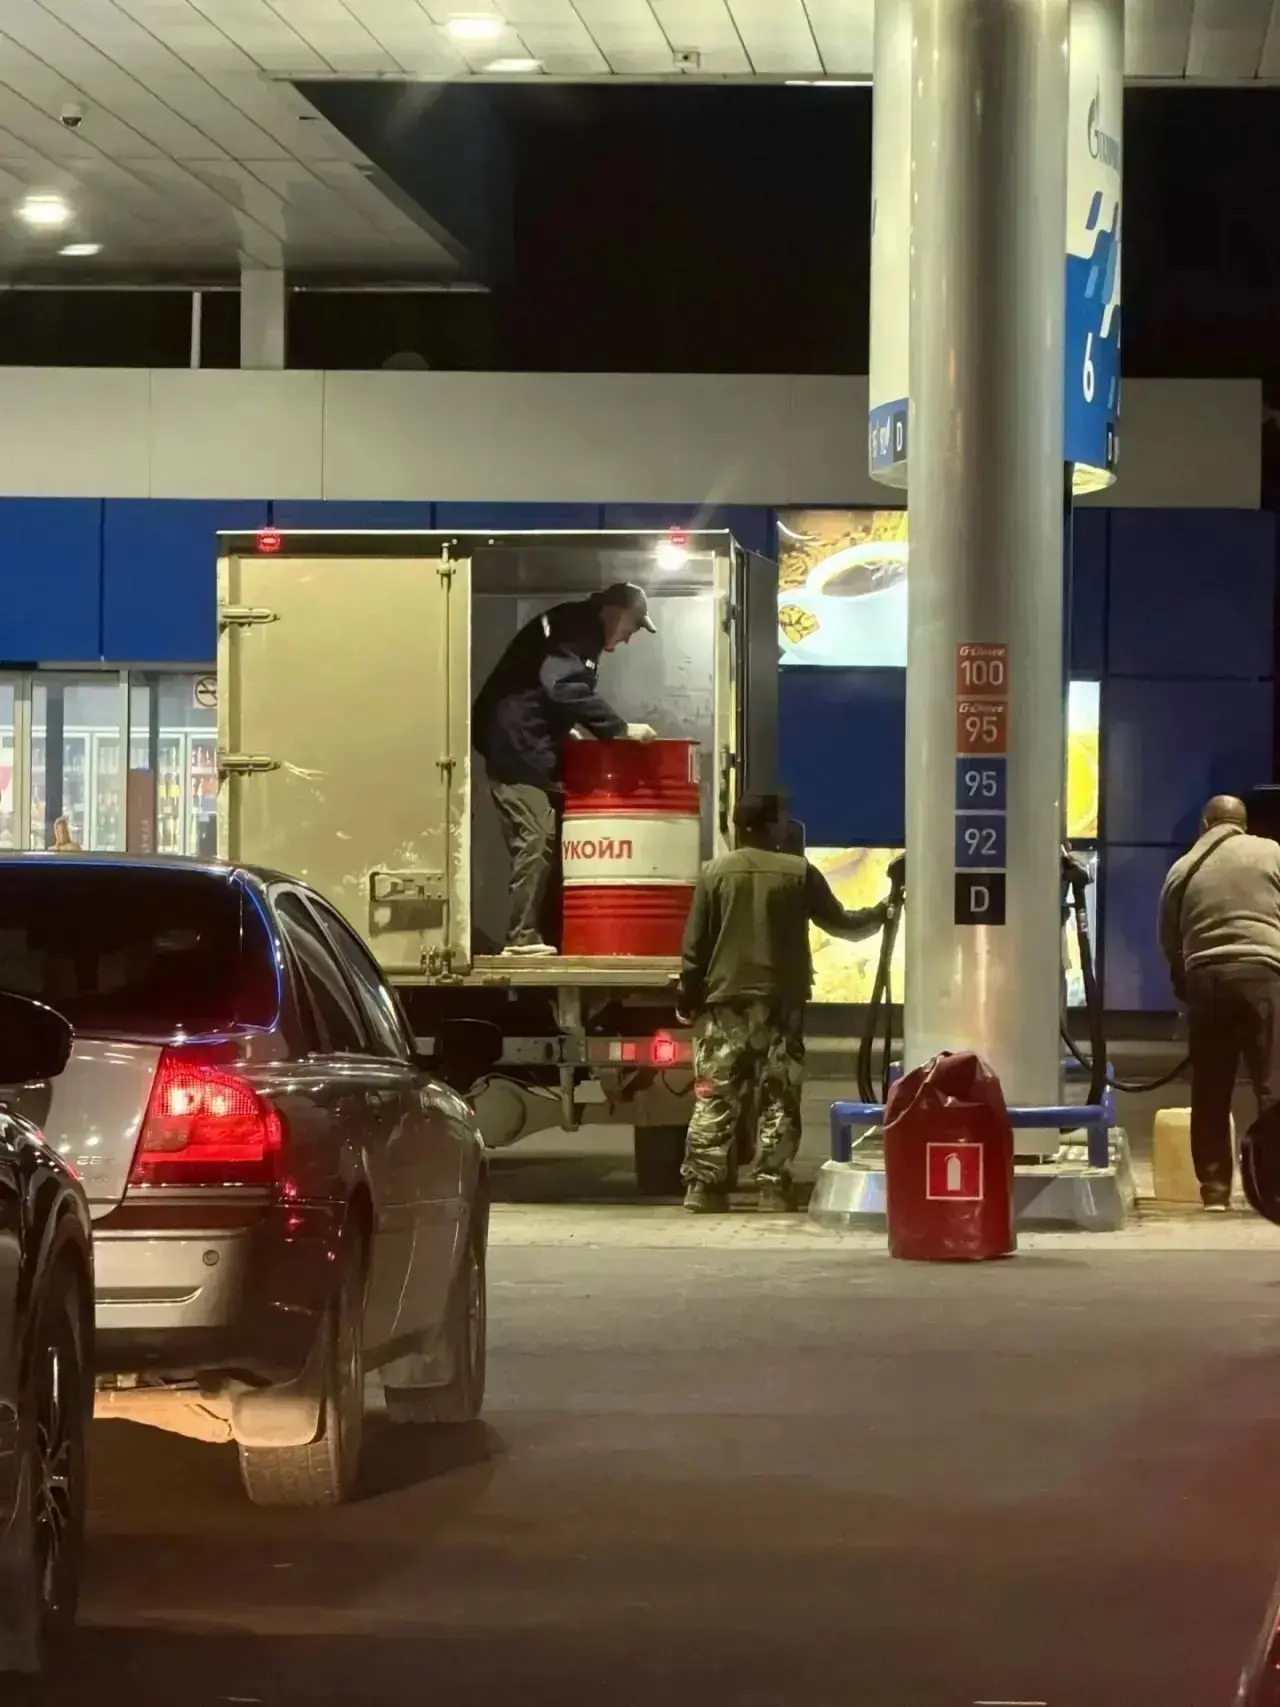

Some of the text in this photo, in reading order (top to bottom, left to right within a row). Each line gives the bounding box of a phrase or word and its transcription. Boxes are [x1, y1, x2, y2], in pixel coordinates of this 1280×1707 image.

[1083, 332, 1094, 403] 6
[896, 421, 903, 452] D
[960, 660, 1003, 685] 100
[965, 716, 998, 743] 95
[965, 771, 997, 796] 95
[563, 837, 632, 860] УКОЙЛ
[964, 828, 997, 855] 92
[970, 886, 990, 912] D
